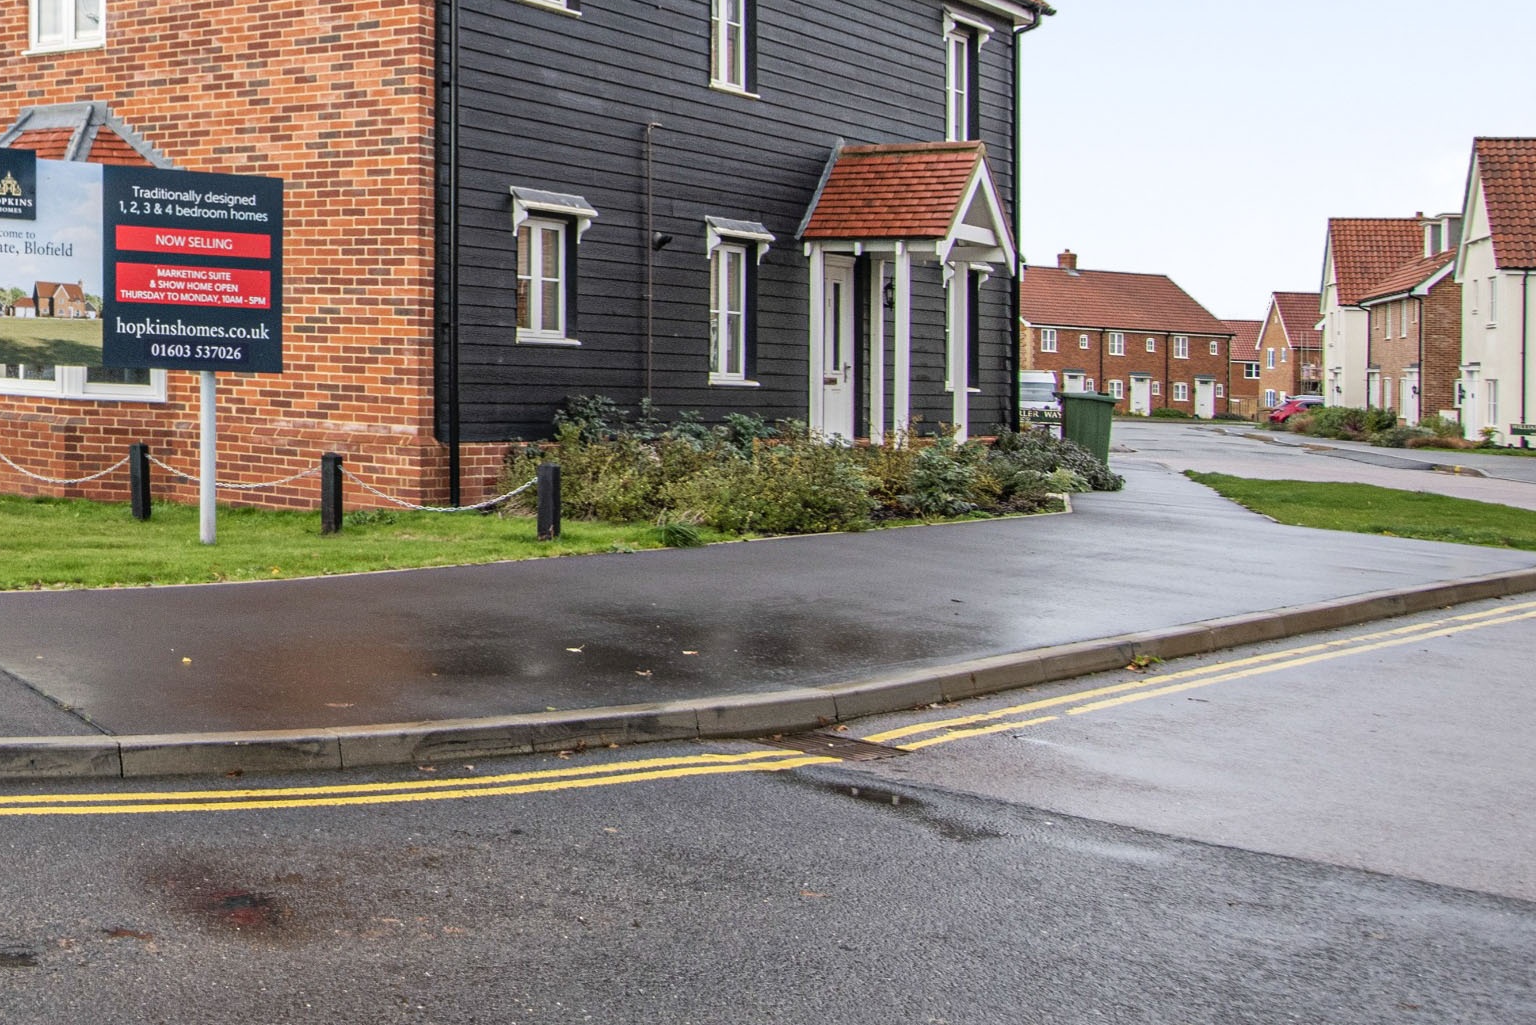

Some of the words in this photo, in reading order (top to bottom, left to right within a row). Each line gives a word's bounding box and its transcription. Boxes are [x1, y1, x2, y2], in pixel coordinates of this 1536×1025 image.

[132, 185, 202, 205] Traditionally
[204, 191, 257, 207] designed
[119, 200, 127, 214] 1,
[130, 201, 140, 215] 2,
[143, 202, 151, 214] 3
[153, 202, 163, 215] &
[165, 204, 173, 215] 4
[175, 204, 228, 219] bedroom
[230, 208, 269, 222] homes
[26, 231, 36, 240] to
[155, 234, 186, 247] NOW
[188, 236, 233, 250] SELLING
[24, 241, 73, 257] Blofield
[157, 268, 207, 280] MARKETING
[208, 271, 231, 281] SUITE
[149, 279, 156, 288] &
[158, 280, 185, 290] SHOW
[186, 281, 213, 291] HOME
[215, 283, 239, 293] OPEN
[120, 289, 165, 300] THURSDAY
[167, 292, 179, 301] TO
[180, 293, 221, 304] MONDAY,
[221, 295, 243, 305] 10AM
[249, 296, 267, 305] 5PM
[116, 316, 270, 340] hopkinshomes.co.uk
[150, 343, 191, 358] 01603
[194, 346, 242, 360] 537026
